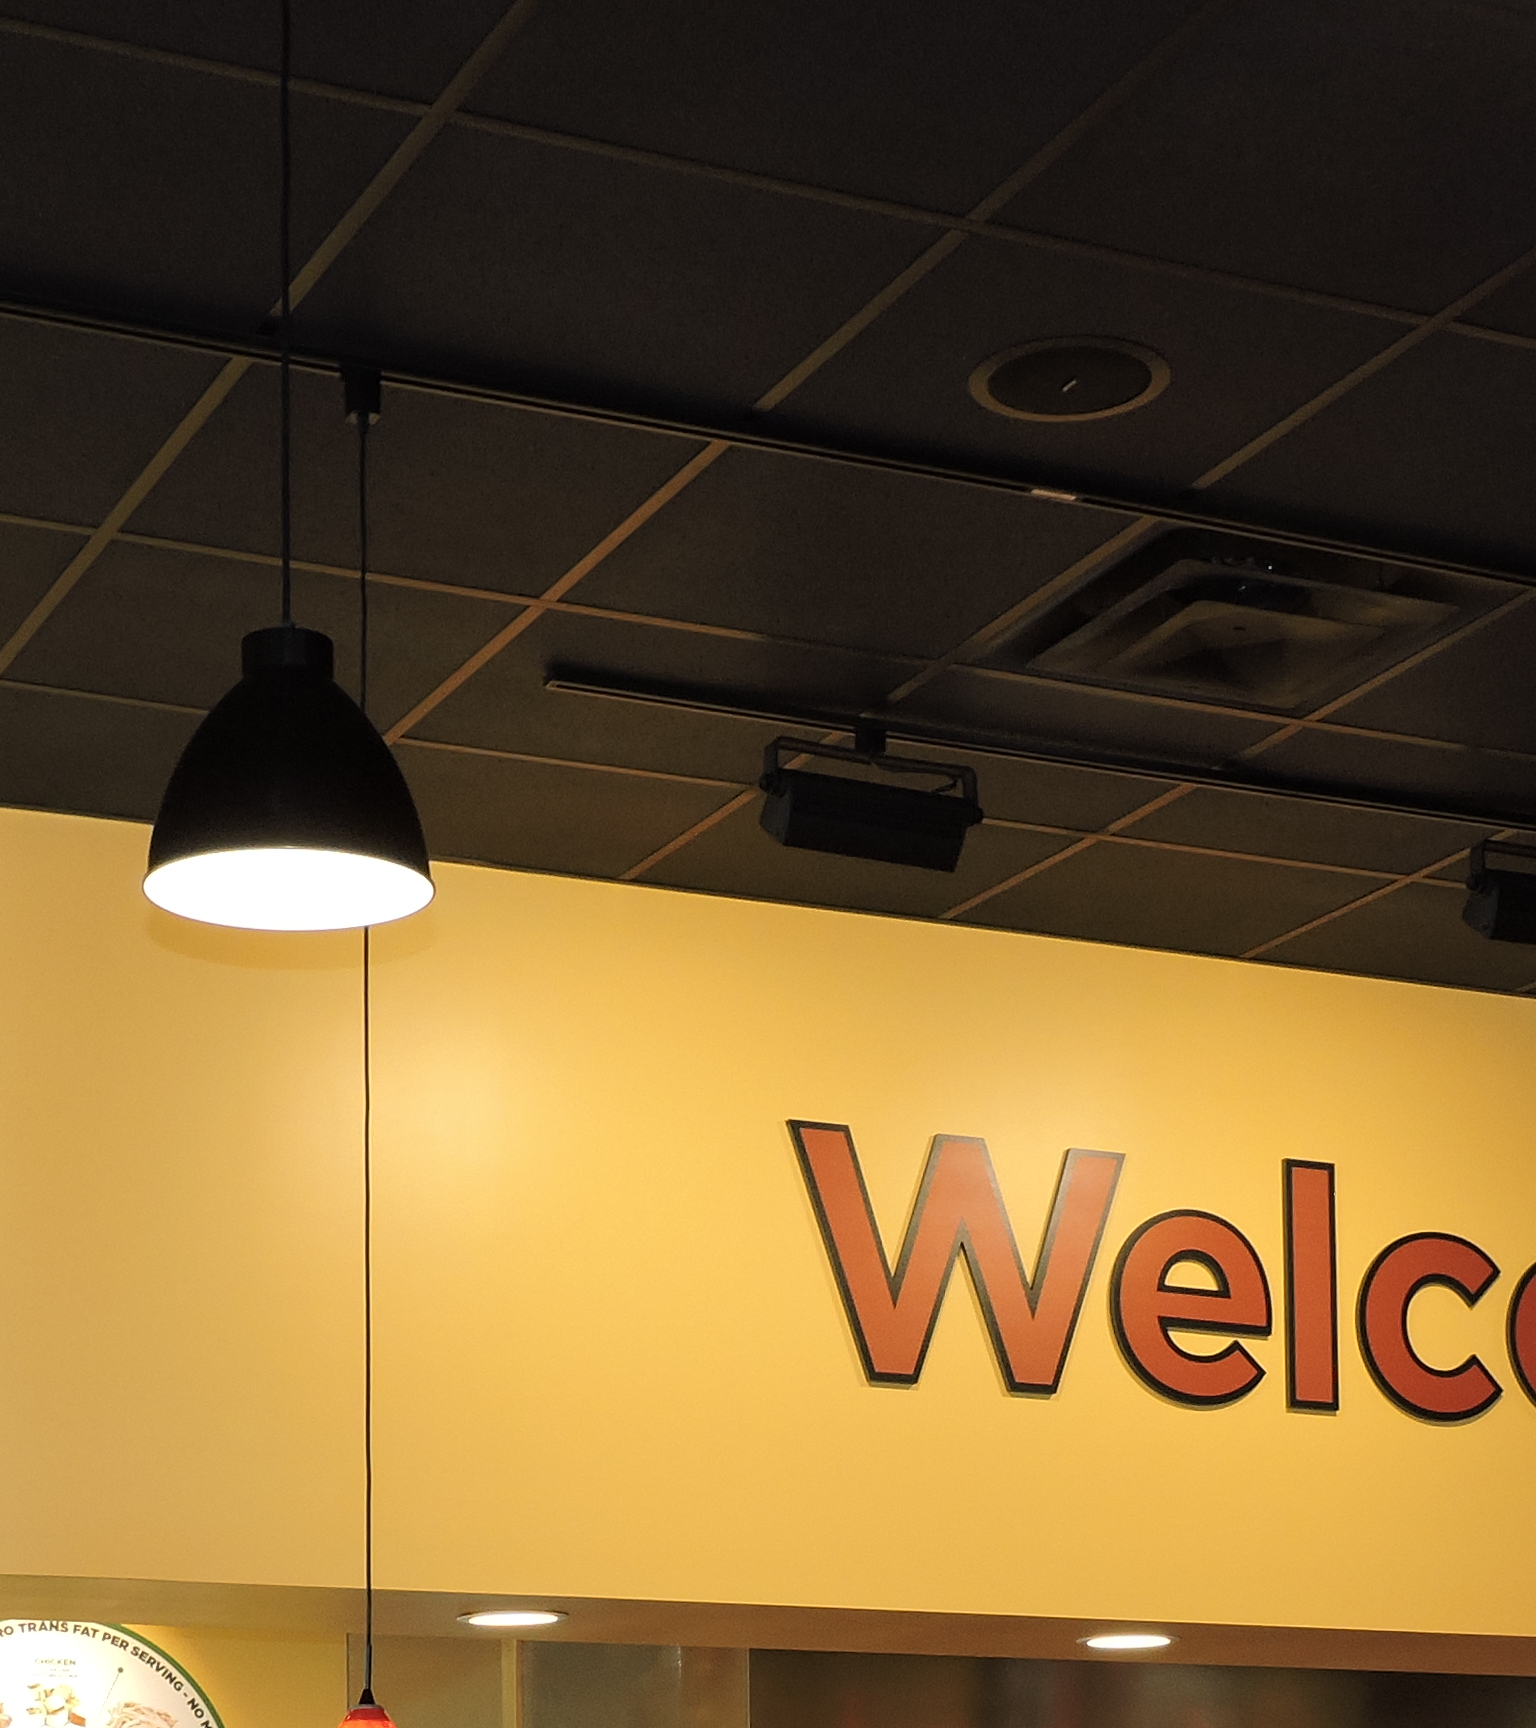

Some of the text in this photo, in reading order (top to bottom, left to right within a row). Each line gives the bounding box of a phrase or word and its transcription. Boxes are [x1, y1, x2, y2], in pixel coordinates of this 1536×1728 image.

[18, 1620, 69, 1634] TRANS
[73, 1624, 100, 1639] FAT
[101, 1632, 129, 1651] PER
[130, 1645, 184, 1692] SERVING
[186, 1697, 205, 1719] NO
